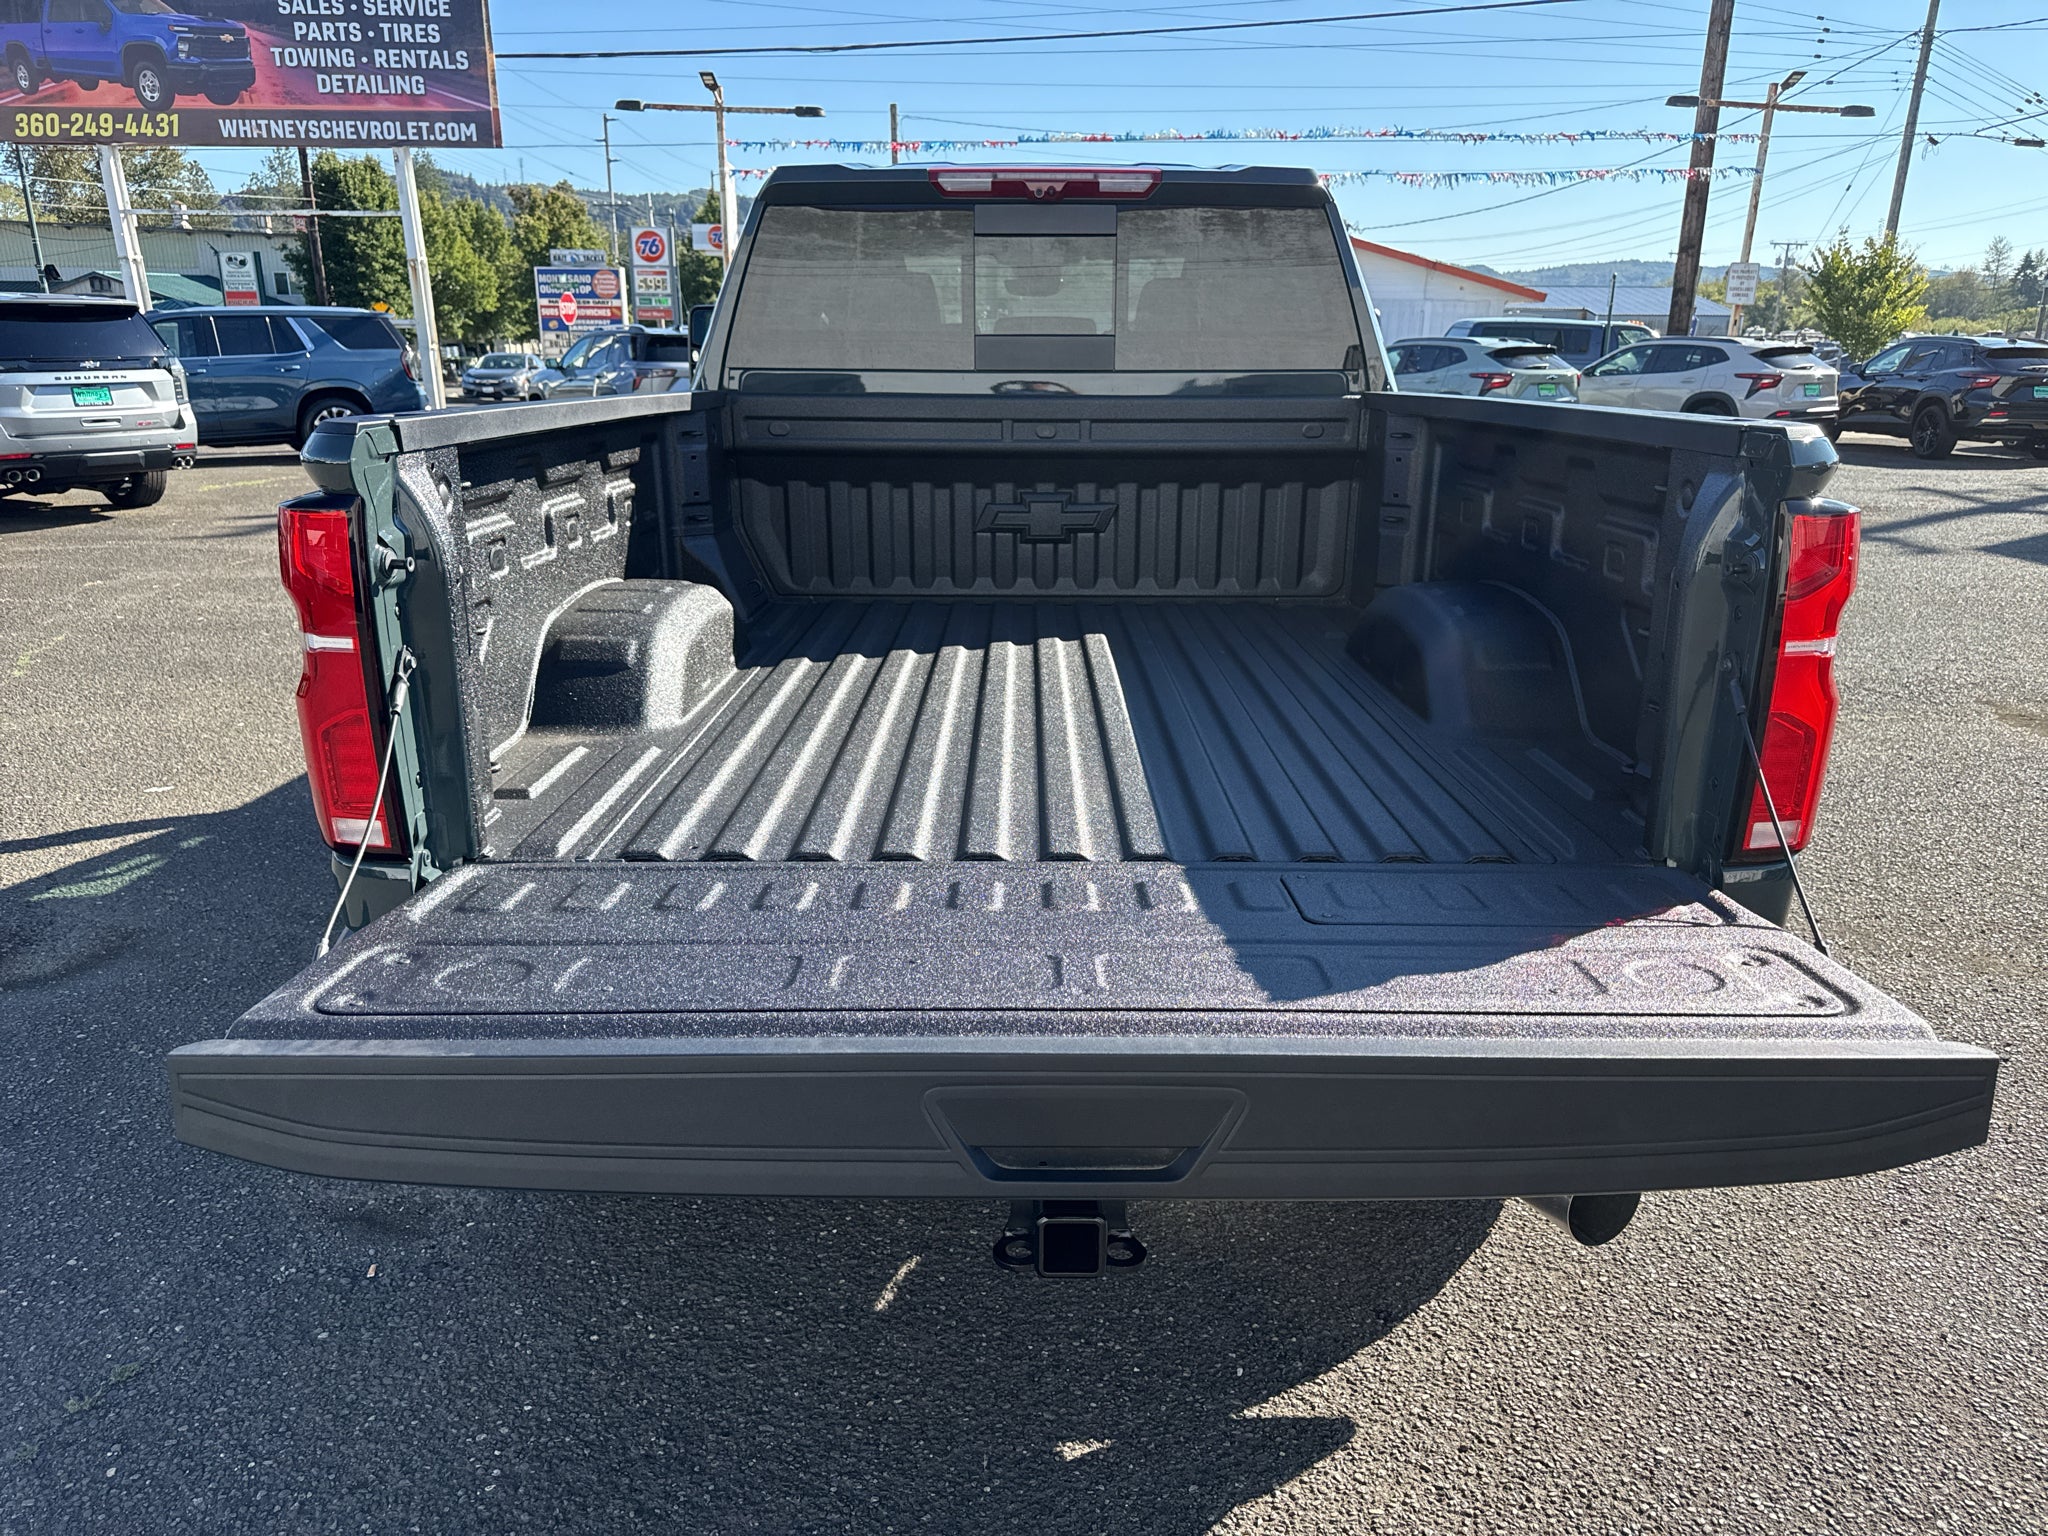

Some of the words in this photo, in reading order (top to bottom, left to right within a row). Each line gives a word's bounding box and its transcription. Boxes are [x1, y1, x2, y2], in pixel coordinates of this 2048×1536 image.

[278, 0, 345, 15] SALES
[363, 0, 452, 17] SERVICE
[293, 21, 362, 42] PARTS
[379, 23, 441, 43] TIRES
[270, 47, 356, 68] TOWING
[373, 49, 469, 70] RENTALS
[316, 74, 426, 95] DETAILING
[15, 112, 180, 137] 360-249-4431
[218, 119, 478, 142] WHITNEYSCHEVROLET.COM
[639, 237, 660, 256] 76
[538, 273, 592, 284] MONTSANO
[561, 302, 576, 314] STOP
